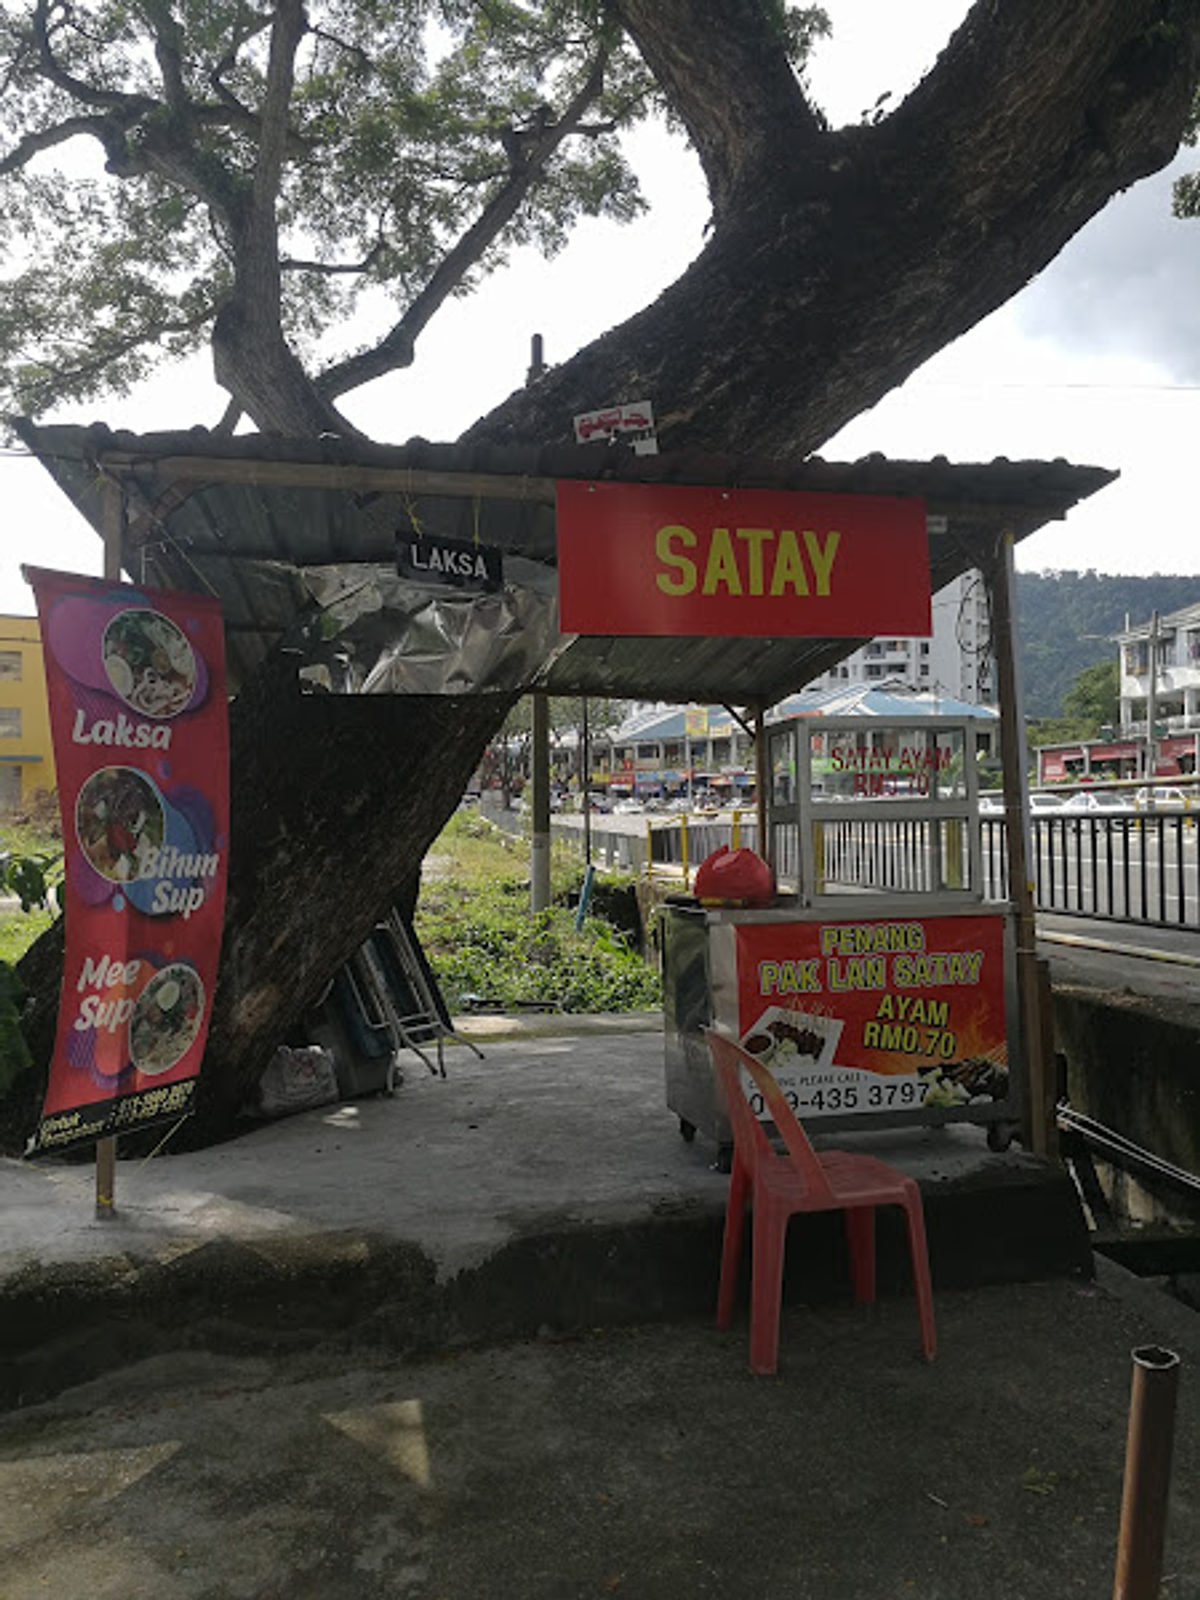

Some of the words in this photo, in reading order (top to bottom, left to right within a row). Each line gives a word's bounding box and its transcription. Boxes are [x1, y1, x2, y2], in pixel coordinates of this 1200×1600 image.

[410, 543, 489, 581] LAKSA
[656, 525, 841, 596] SATAY
[71, 708, 172, 749] Laksa
[831, 746, 894, 772] SATAY
[899, 746, 951, 771] AYAM
[135, 846, 220, 880] Bihun
[151, 880, 205, 919] Sup
[821, 924, 925, 955] PENANG
[76, 955, 141, 993] Mee
[760, 960, 822, 995] PAK
[827, 956, 886, 991] LAN
[893, 950, 984, 989] SATAY
[73, 995, 137, 1033] Sup
[876, 994, 949, 1028] AYAM
[863, 1022, 956, 1058] RM0.70
[868, 1082, 930, 1107] 3797
